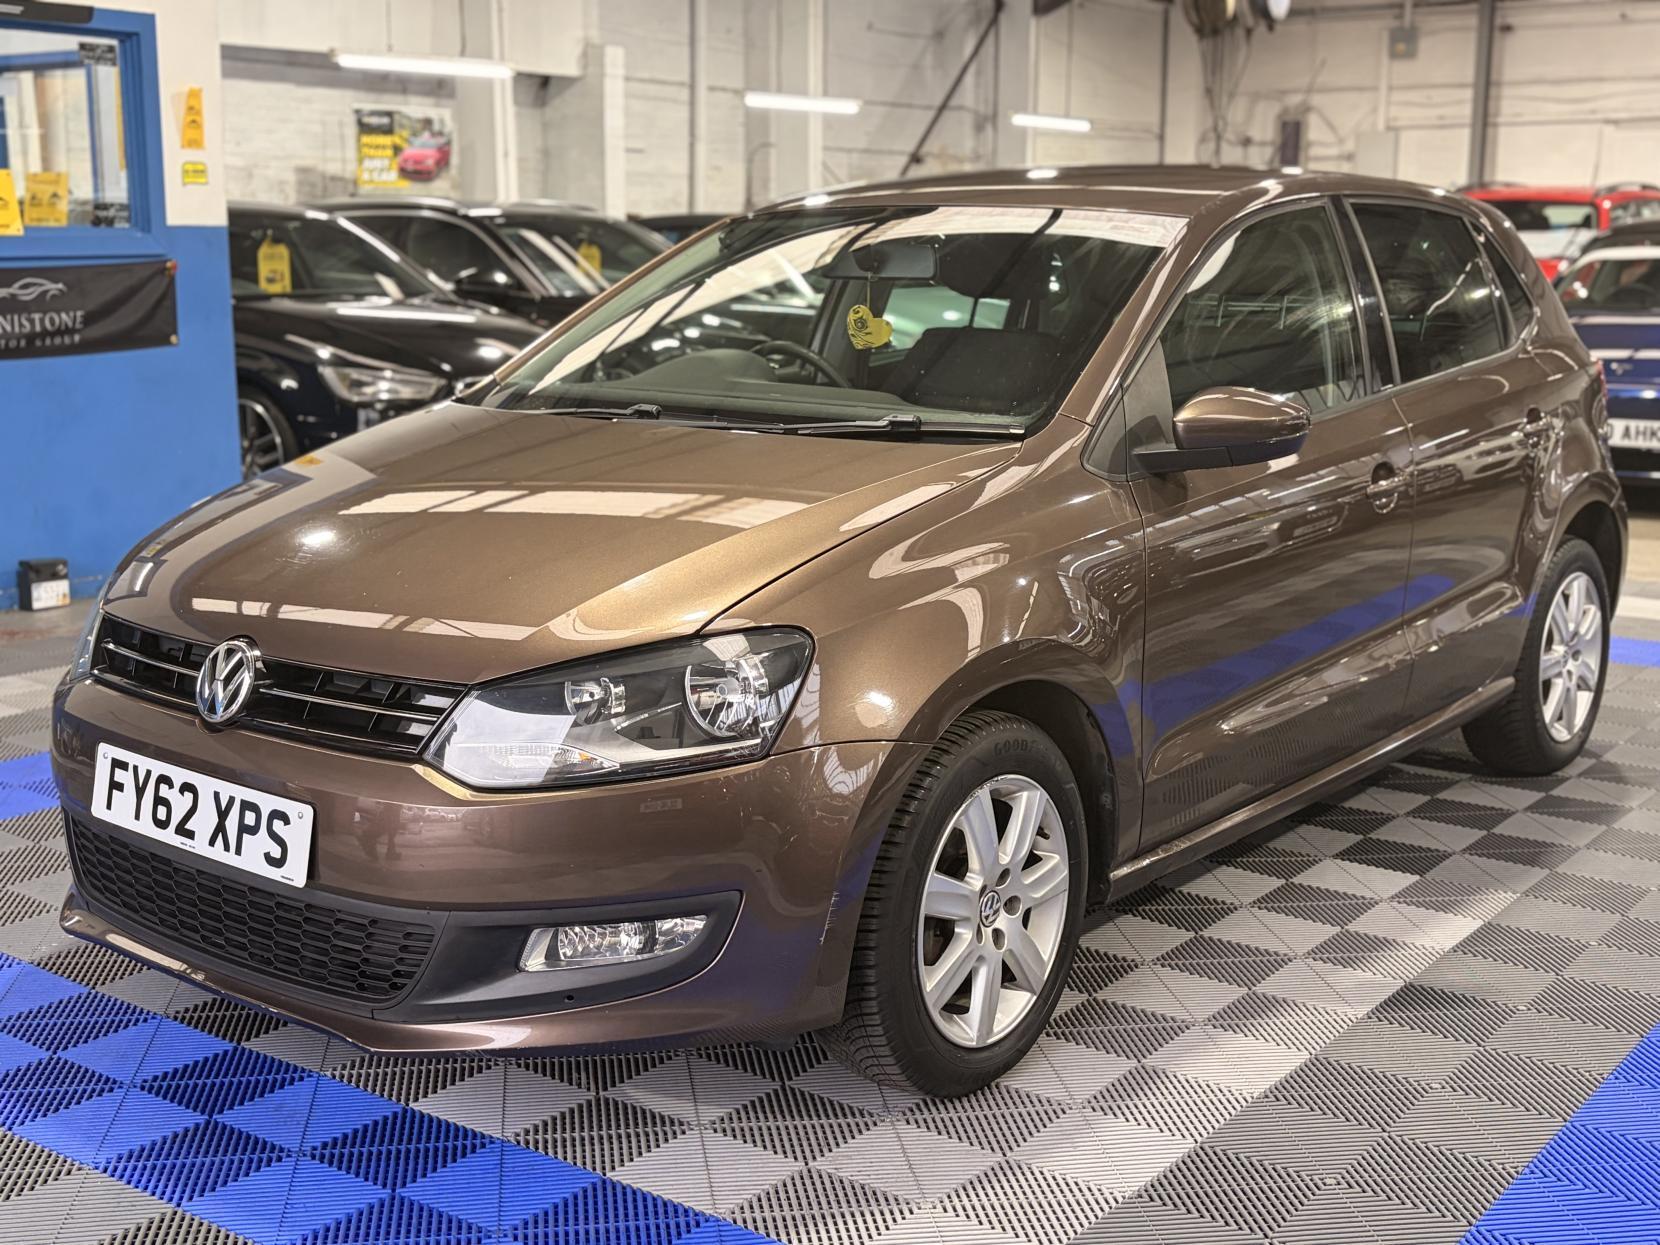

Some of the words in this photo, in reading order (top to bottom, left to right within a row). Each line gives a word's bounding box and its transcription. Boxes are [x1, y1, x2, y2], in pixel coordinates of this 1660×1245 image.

[35, 333, 81, 347] GROUP
[106, 757, 199, 841] FY62
[208, 790, 291, 869] XPS
